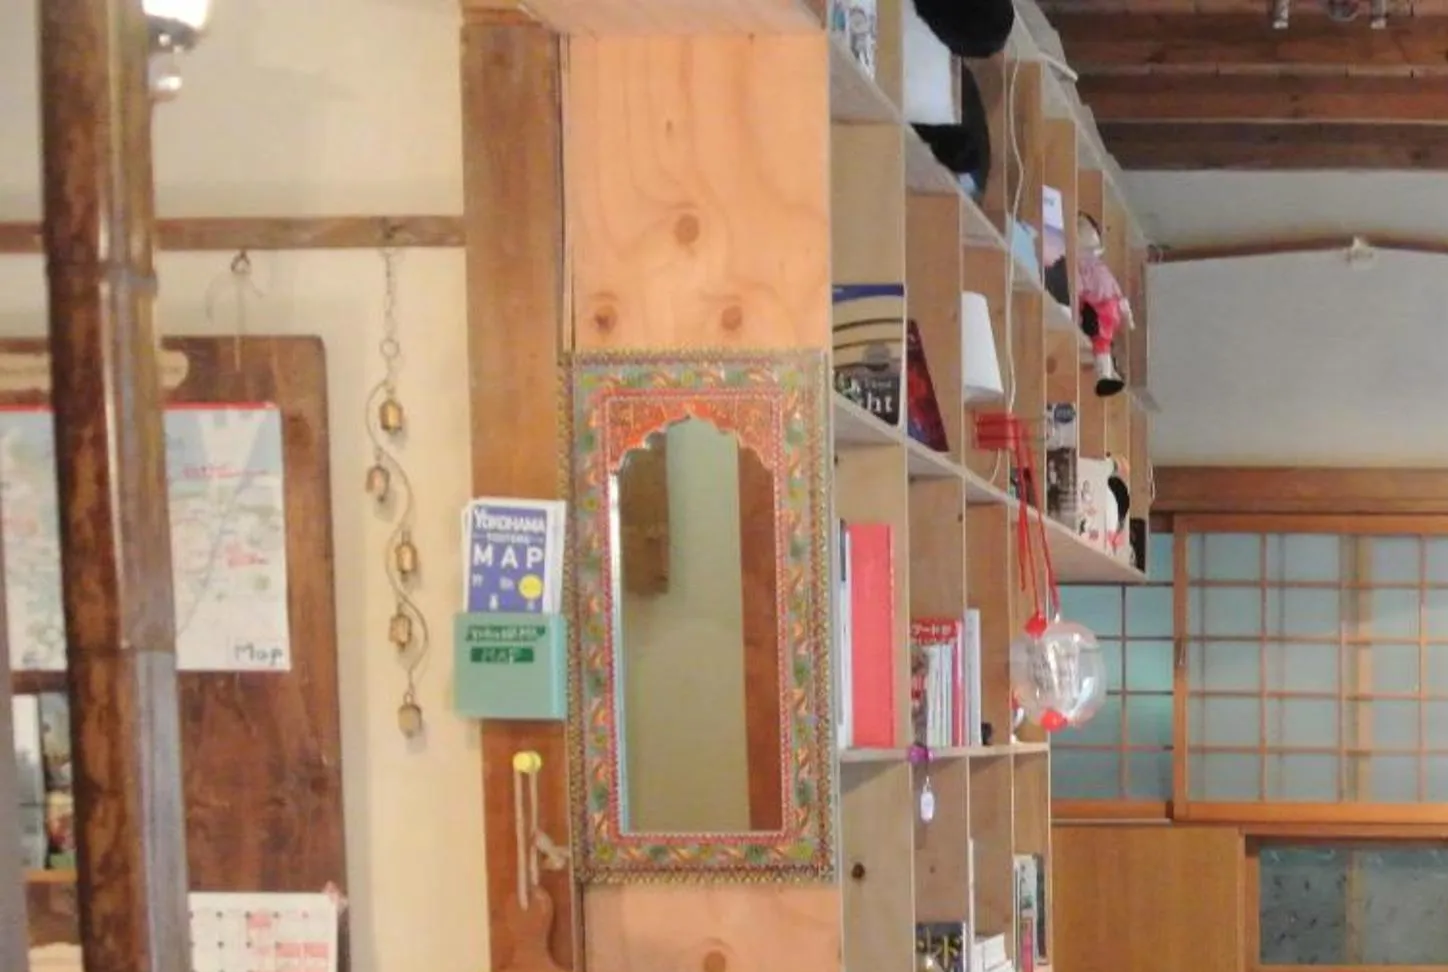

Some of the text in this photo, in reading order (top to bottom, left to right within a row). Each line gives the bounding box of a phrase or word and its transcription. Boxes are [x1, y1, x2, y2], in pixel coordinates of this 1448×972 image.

[474, 507, 545, 532] YOKOHAMA
[472, 542, 544, 569] MAP
[233, 641, 284, 666] Map
